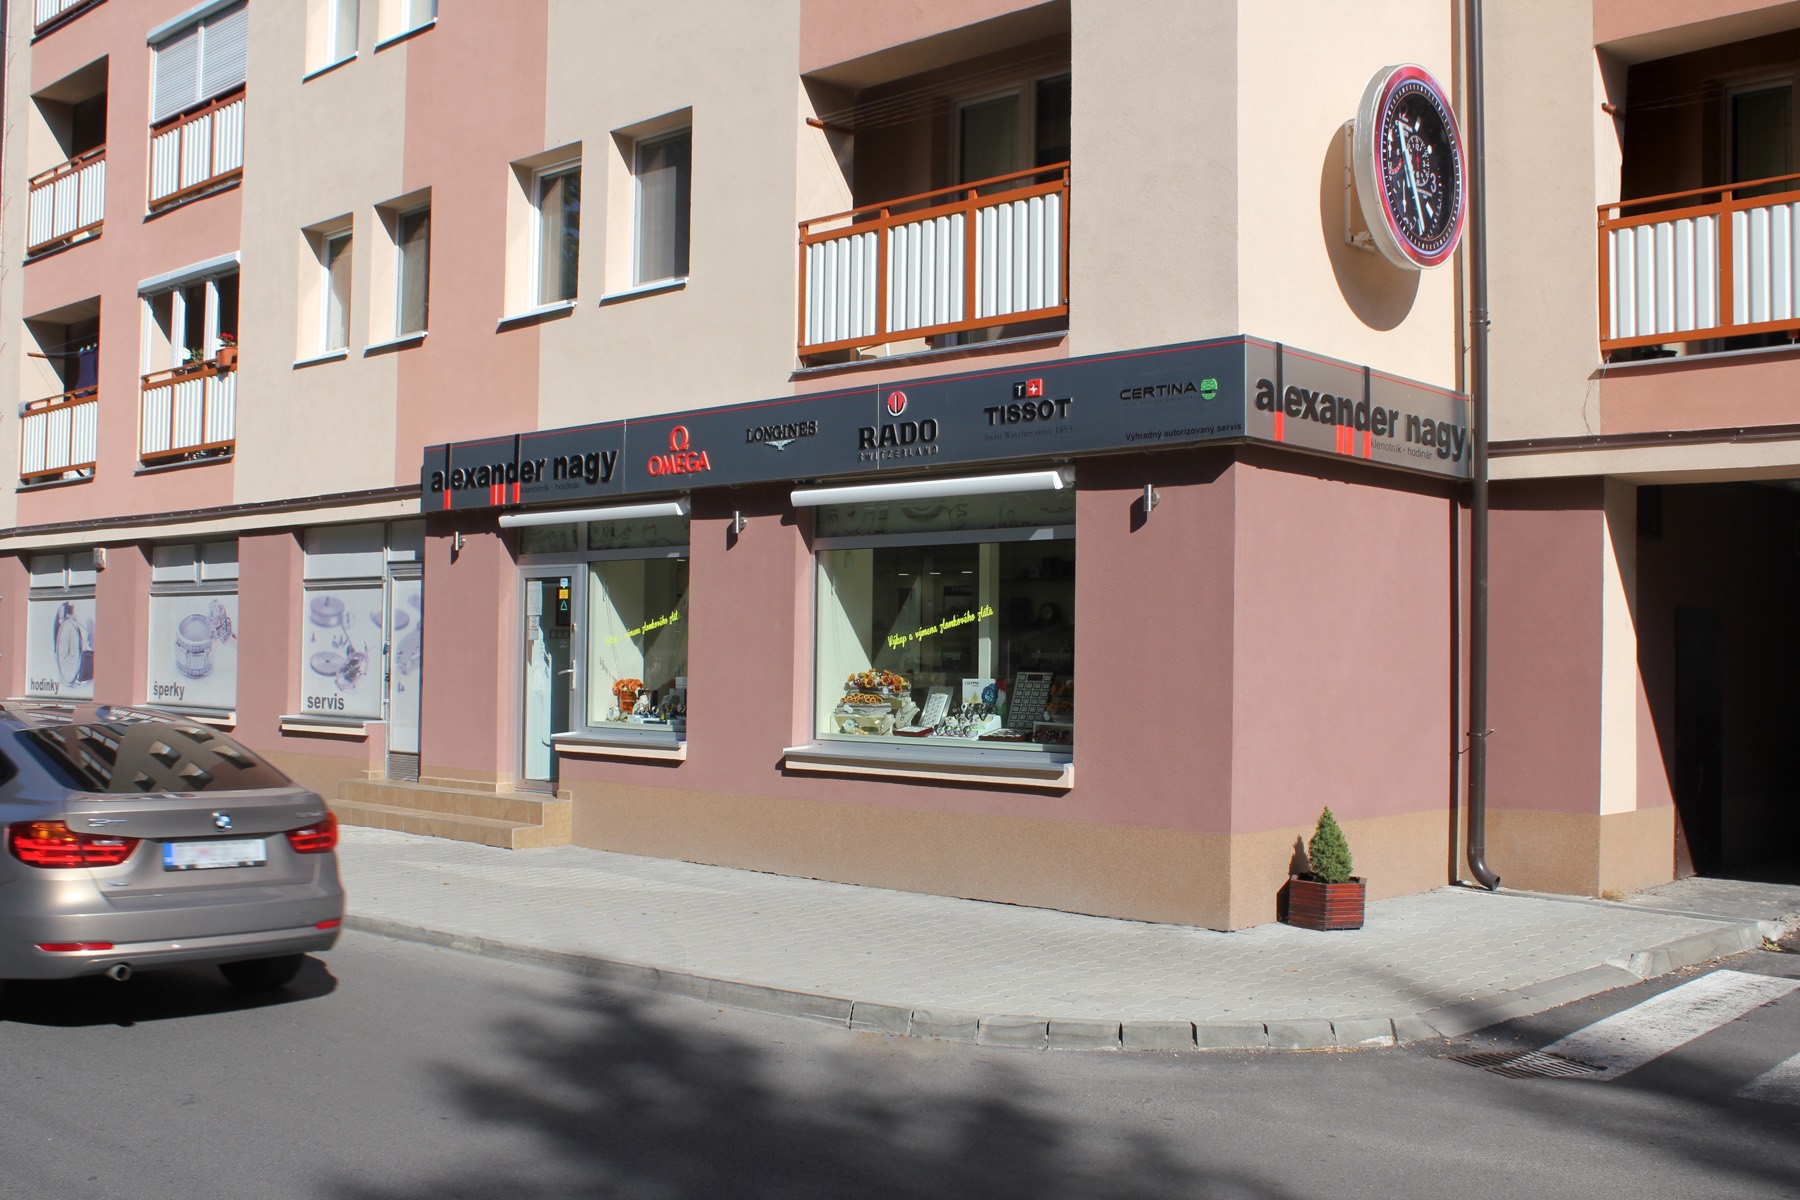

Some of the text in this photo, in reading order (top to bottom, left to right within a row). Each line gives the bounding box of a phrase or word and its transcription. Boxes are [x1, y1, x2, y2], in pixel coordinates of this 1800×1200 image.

[1120, 381, 1198, 401] CERTINA
[983, 397, 1073, 426] TISSOT
[1255, 342, 1466, 462] alexander nagy
[745, 420, 818, 443] LONGINES
[858, 418, 939, 450] RADO
[984, 433, 1003, 442] Swiss
[1004, 428, 1033, 440] Watches
[1034, 426, 1054, 436] since
[1125, 422, 1242, 442] Výhradný autorizovaný servis
[431, 435, 619, 493] alexander nagy
[647, 450, 711, 477] OMEGA
[858, 445, 939, 463] SWITZERLAND
[914, 626, 938, 642] výmena
[30, 678, 60, 695] hodinky
[153, 681, 185, 701] šperky
[307, 693, 345, 710] servis
